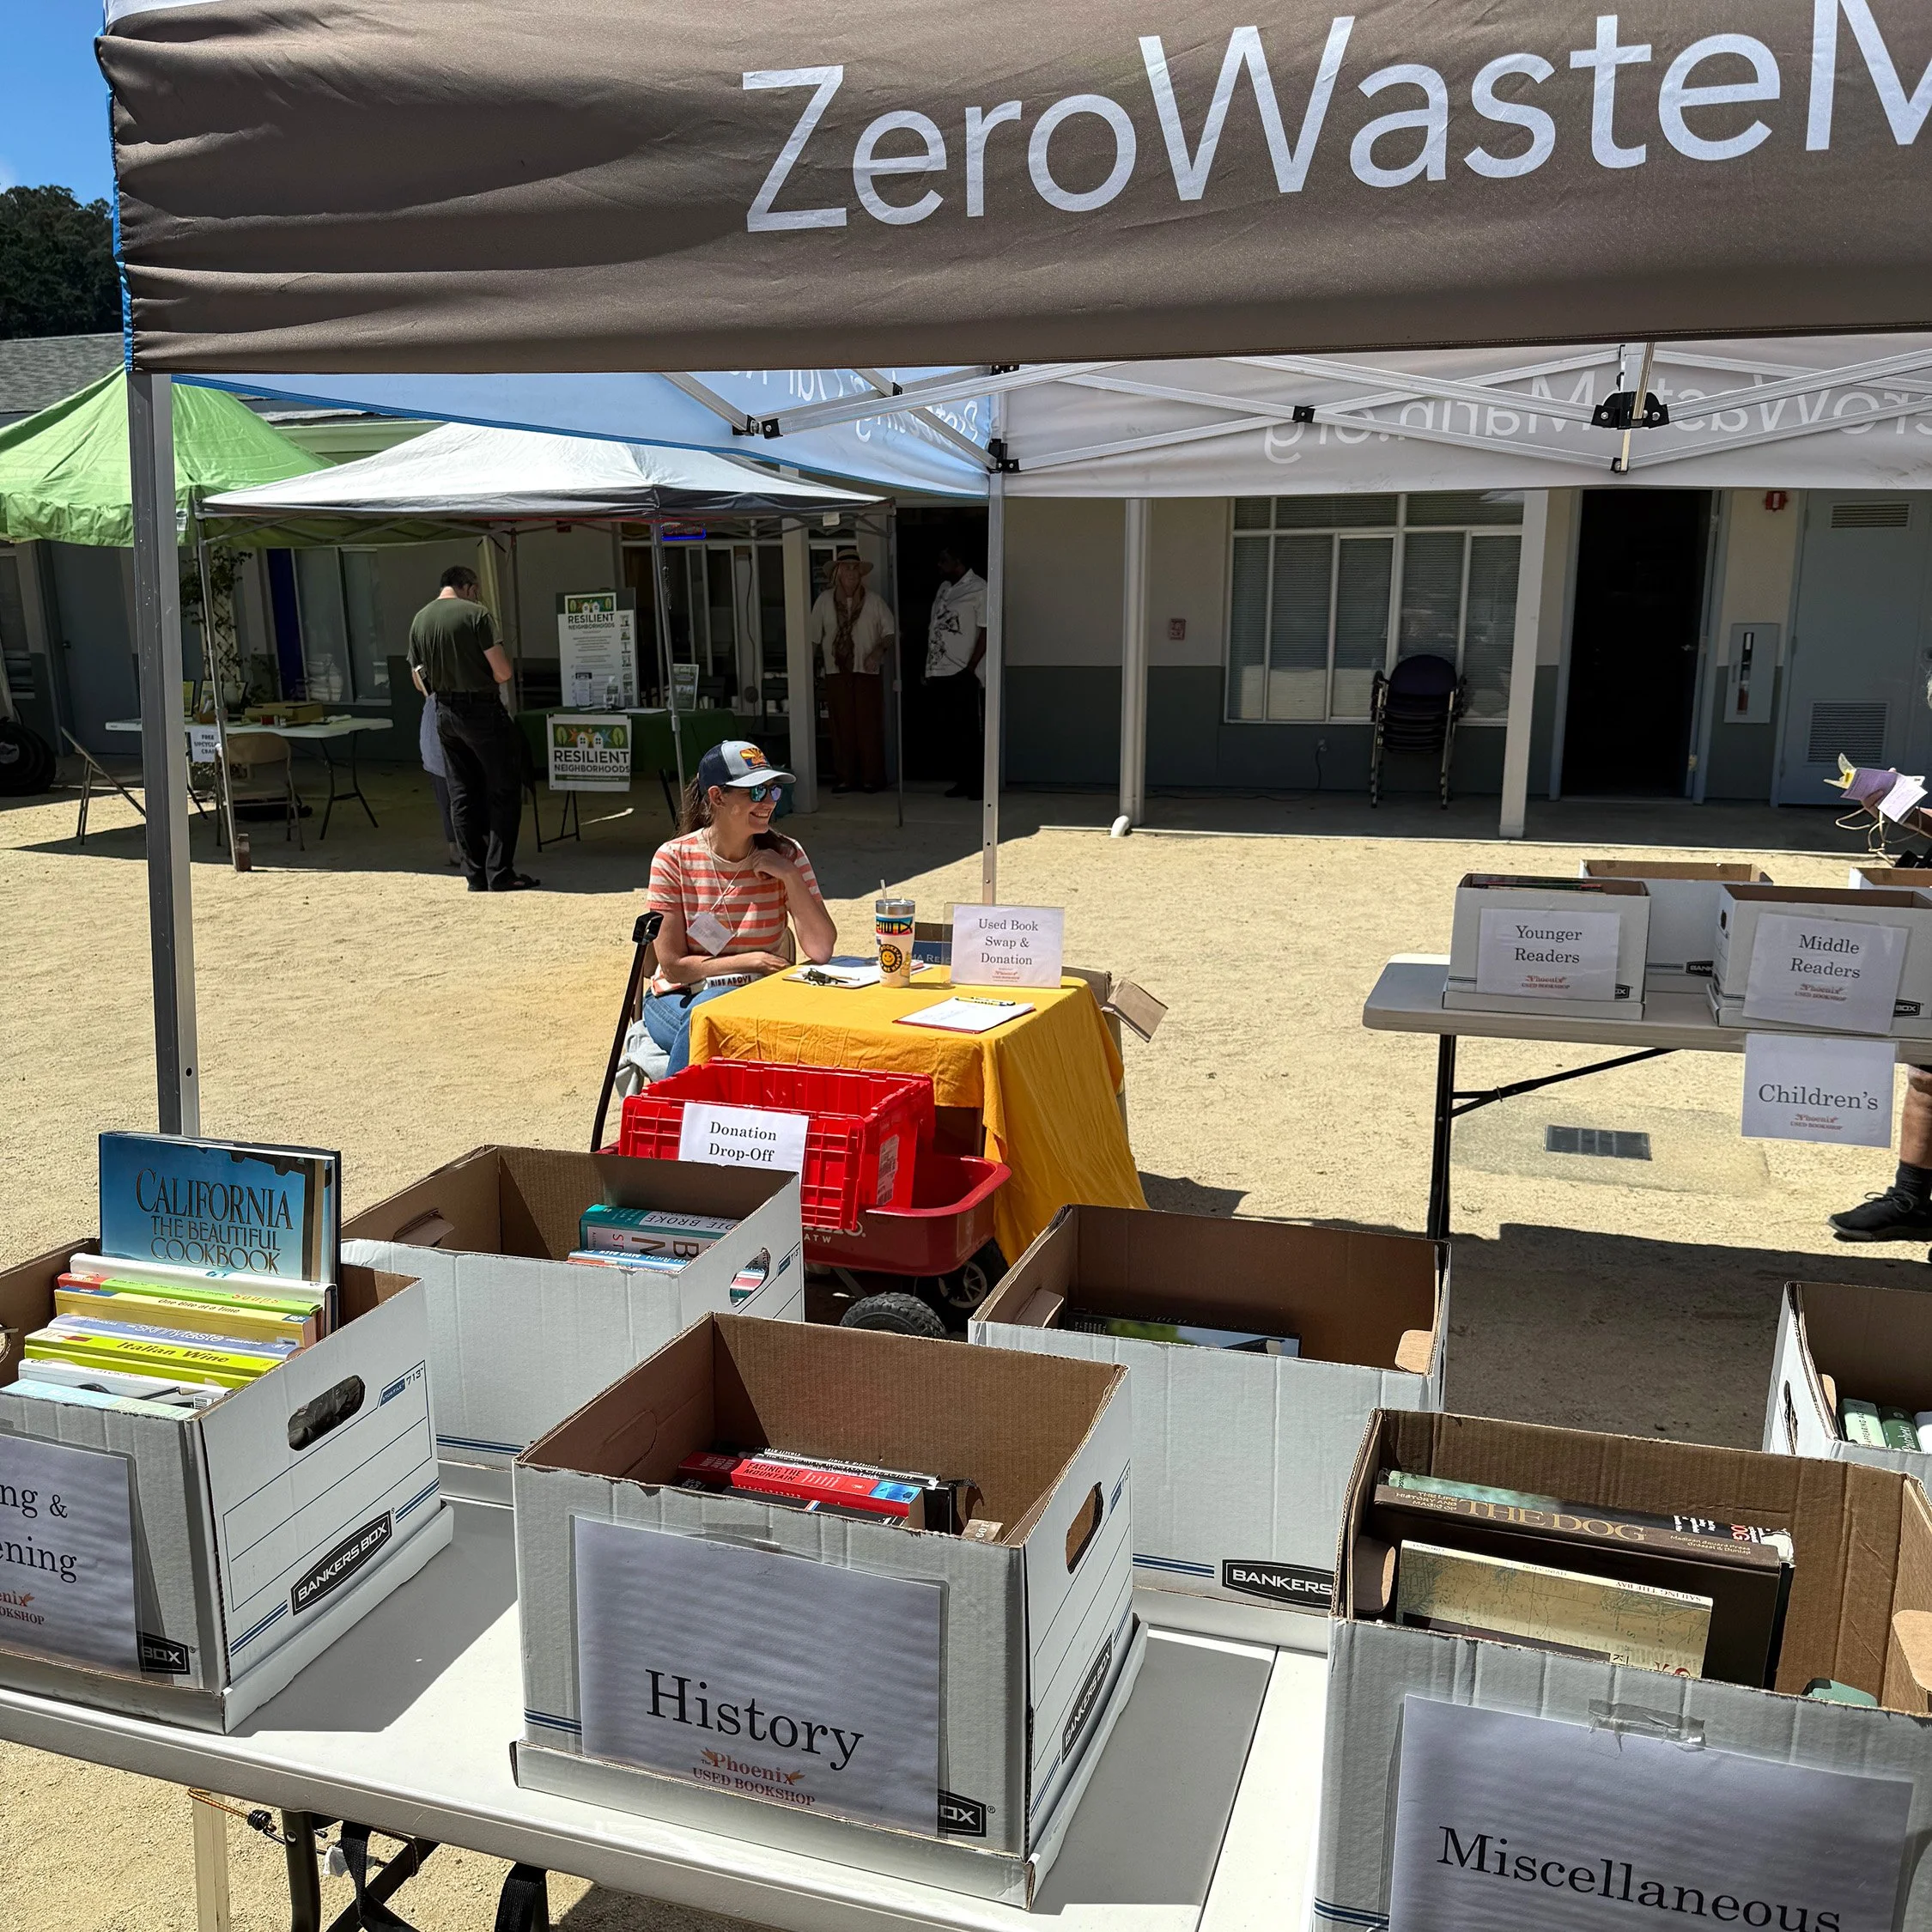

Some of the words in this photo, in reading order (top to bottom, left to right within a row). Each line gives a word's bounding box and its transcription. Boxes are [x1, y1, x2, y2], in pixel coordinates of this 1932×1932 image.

[568, 613, 615, 623] RESILIENT
[568, 622, 616, 630] NEIGHBORHOODS
[554, 750, 629, 764] RESILIENT
[554, 763, 631, 774] NEIGHBORHOODS
[979, 918, 1007, 931] Used
[1011, 920, 1039, 932] Book
[1515, 925, 1583, 944] Younger
[985, 936, 1017, 950] Swap
[1020, 937, 1030, 948] &
[1798, 933, 1861, 955] Middle
[981, 952, 1033, 966] Donation
[1515, 947, 1581, 963] Readers
[1789, 957, 1862, 979] Readers
[726, 975, 752, 985] ABOVE
[1759, 1084, 1879, 1110] Children’s
[710, 1121, 777, 1141] Donation
[708, 1142, 775, 1163] Drop-Off
[136, 1168, 294, 1230] CALIFORNIA
[644, 1214, 701, 1228] BROKE
[151, 1215, 183, 1238] THE
[188, 1220, 282, 1251] BEAUTIFUL
[150, 1237, 281, 1275] COOKBOOK
[158, 1297, 175, 1306] One
[219, 1306, 240, 1315] Time
[134, 1323, 226, 1342] skinnytaste
[117, 1341, 174, 1356] Italian
[182, 1350, 230, 1364] Wine
[406, 1369, 422, 1385] 713
[743, 1469, 797, 1481] MOUNTAIN
[745, 1461, 783, 1473] FACING
[783, 1466, 804, 1477] THE
[49, 1494, 68, 1518] &
[1395, 1492, 1437, 1504] HISTORY
[1437, 1498, 1457, 1507] AND
[1412, 1500, 1443, 1510] MAGIC
[1458, 1499, 1546, 1527] THE
[1552, 1513, 1647, 1542] DOG
[1670, 1534, 1701, 1544] Madison
[1701, 1539, 1728, 1547] Square
[1728, 1543, 1751, 1552] Press
[1687, 1542, 1716, 1551] Grosset
[1723, 1546, 1752, 1556] Dunlap
[0, 1535, 77, 1583] ning
[297, 1544, 361, 1602] BANKERS
[361, 1522, 388, 1552] BOX
[1232, 1568, 1333, 1596] BANKERS
[1615, 1580, 1634, 1590] BAY
[1636, 1584, 1659, 1595] THE
[1659, 1588, 1702, 1603] SAILING
[1063, 1679, 1097, 1747] BANKERS
[1096, 1650, 1111, 1680] BOX
[644, 1668, 865, 1772] History
[712, 1751, 795, 1787] Phoenix
[692, 1767, 732, 1787] USED
[734, 1777, 817, 1807] BOOKSHOP
[939, 1803, 977, 1826] OX
[1437, 1826, 1841, 1932] Miscellaneous
